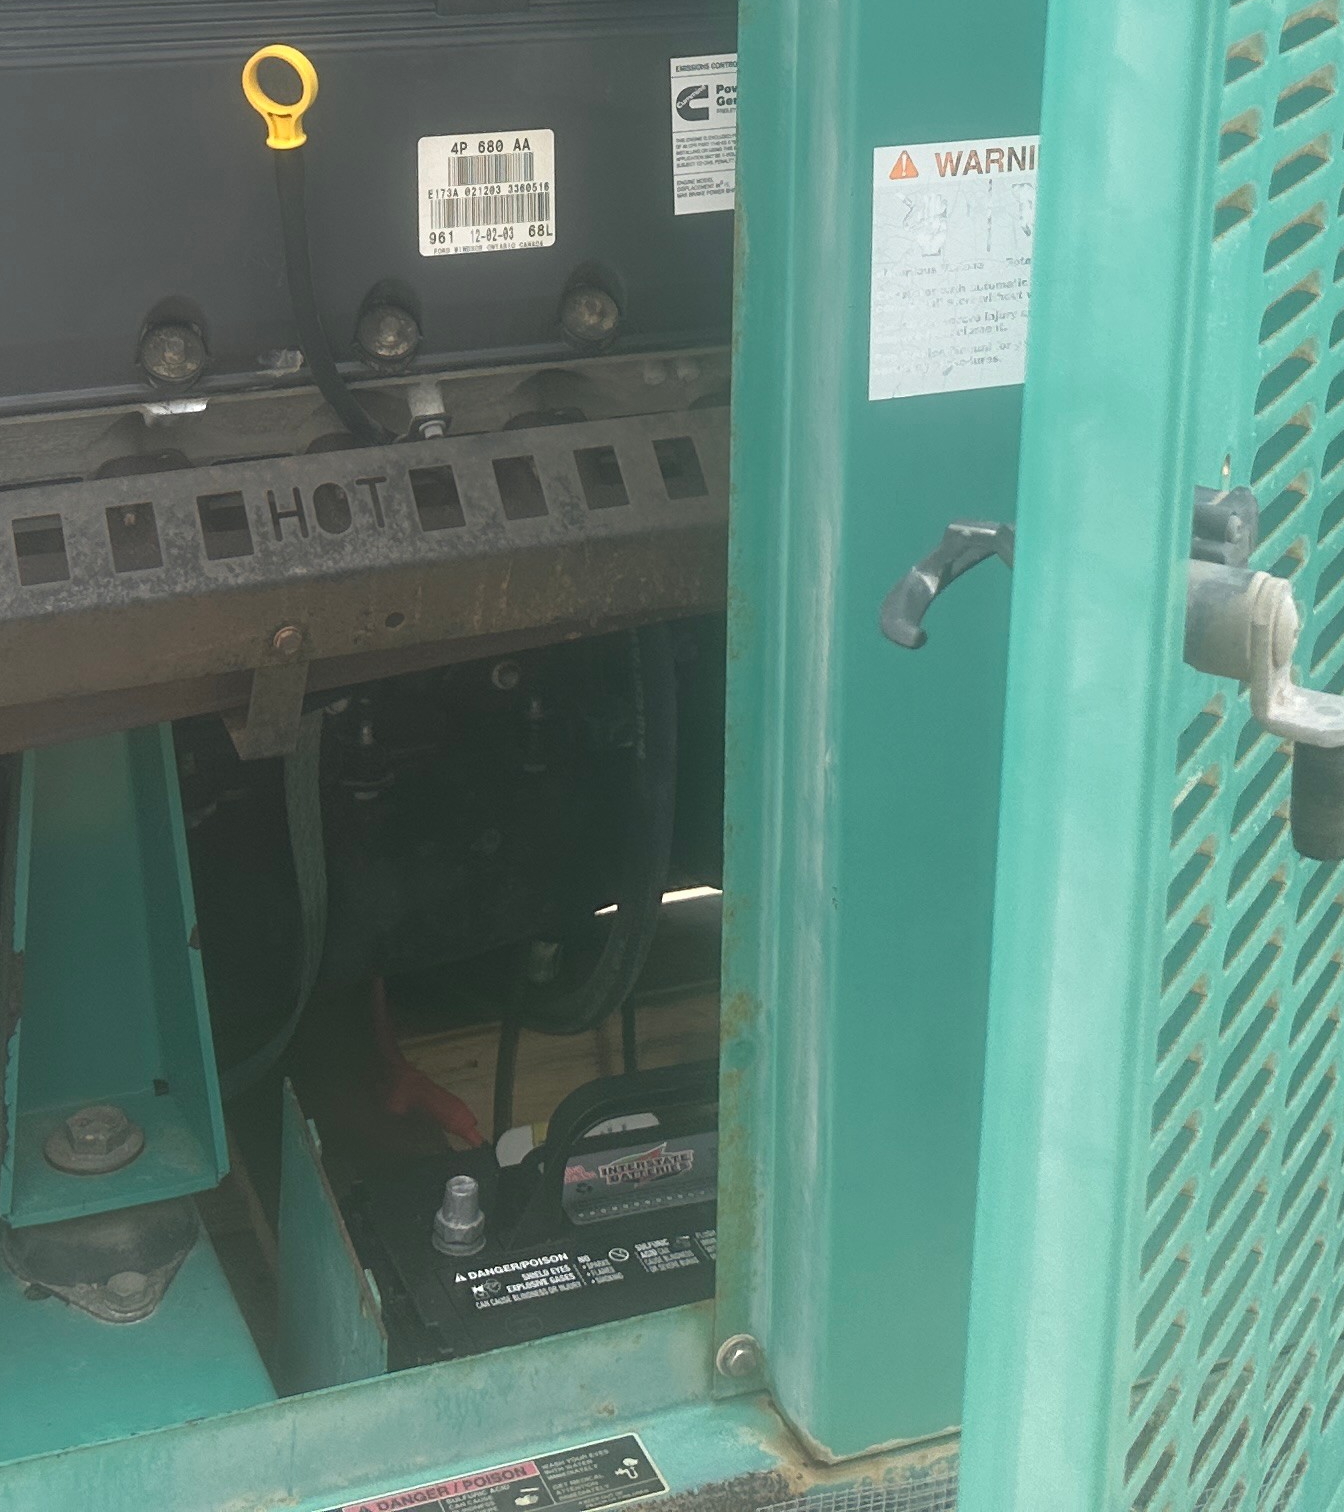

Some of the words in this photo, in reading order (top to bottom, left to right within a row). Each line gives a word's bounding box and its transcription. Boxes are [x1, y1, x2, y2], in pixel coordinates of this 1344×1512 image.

[450, 142, 467, 155] 4P
[478, 139, 504, 153] 680
[513, 138, 531, 151] AA
[428, 188, 458, 199] E173A
[464, 185, 501, 196] 021203
[429, 230, 454, 244] 961
[471, 226, 514, 243] 12-02-03
[528, 224, 553, 237] 68L
[266, 476, 388, 542] HOT
[468, 1252, 568, 1280] DANGER/POISON
[550, 1264, 571, 1275] EYES
[506, 1278, 549, 1293] EXPLOSIVE
[550, 1272, 576, 1284] GASES
[378, 1486, 450, 1511] DANGER
[463, 1466, 528, 1490] POISON
